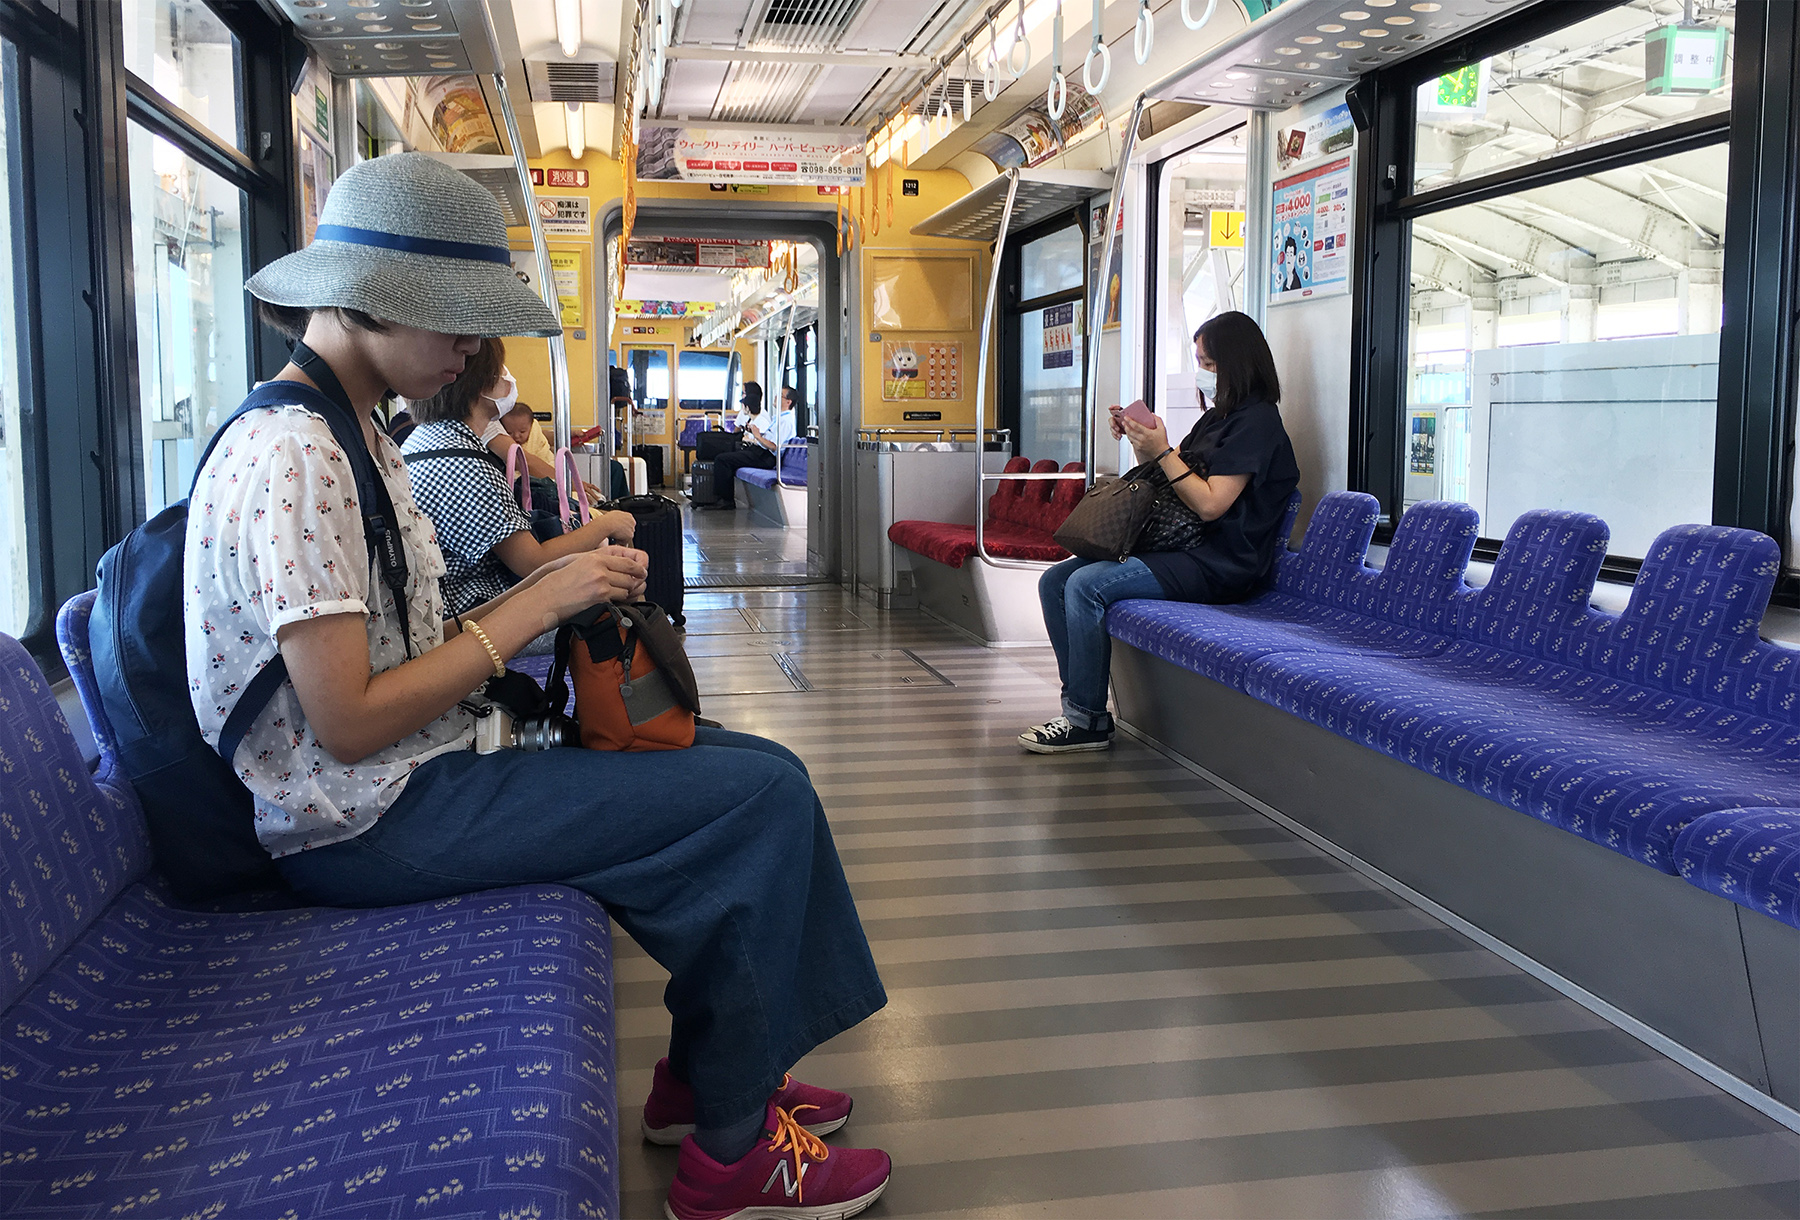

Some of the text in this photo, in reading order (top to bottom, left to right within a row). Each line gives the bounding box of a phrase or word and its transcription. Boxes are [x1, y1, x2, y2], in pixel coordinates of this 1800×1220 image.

[1673, 53, 1714, 65] 調整中
[679, 140, 864, 155] ウィークリー・デイリー ハーバービューマンション
[552, 170, 574, 182] 消火器
[808, 166, 862, 175] 098-855-8111
[557, 201, 579, 209] 痴漢は
[557, 210, 587, 219] 犯罪です
[1045, 312, 1059, 327] 優先席
[385, 530, 397, 567] OLYMPUS
[761, 1158, 810, 1198] N
